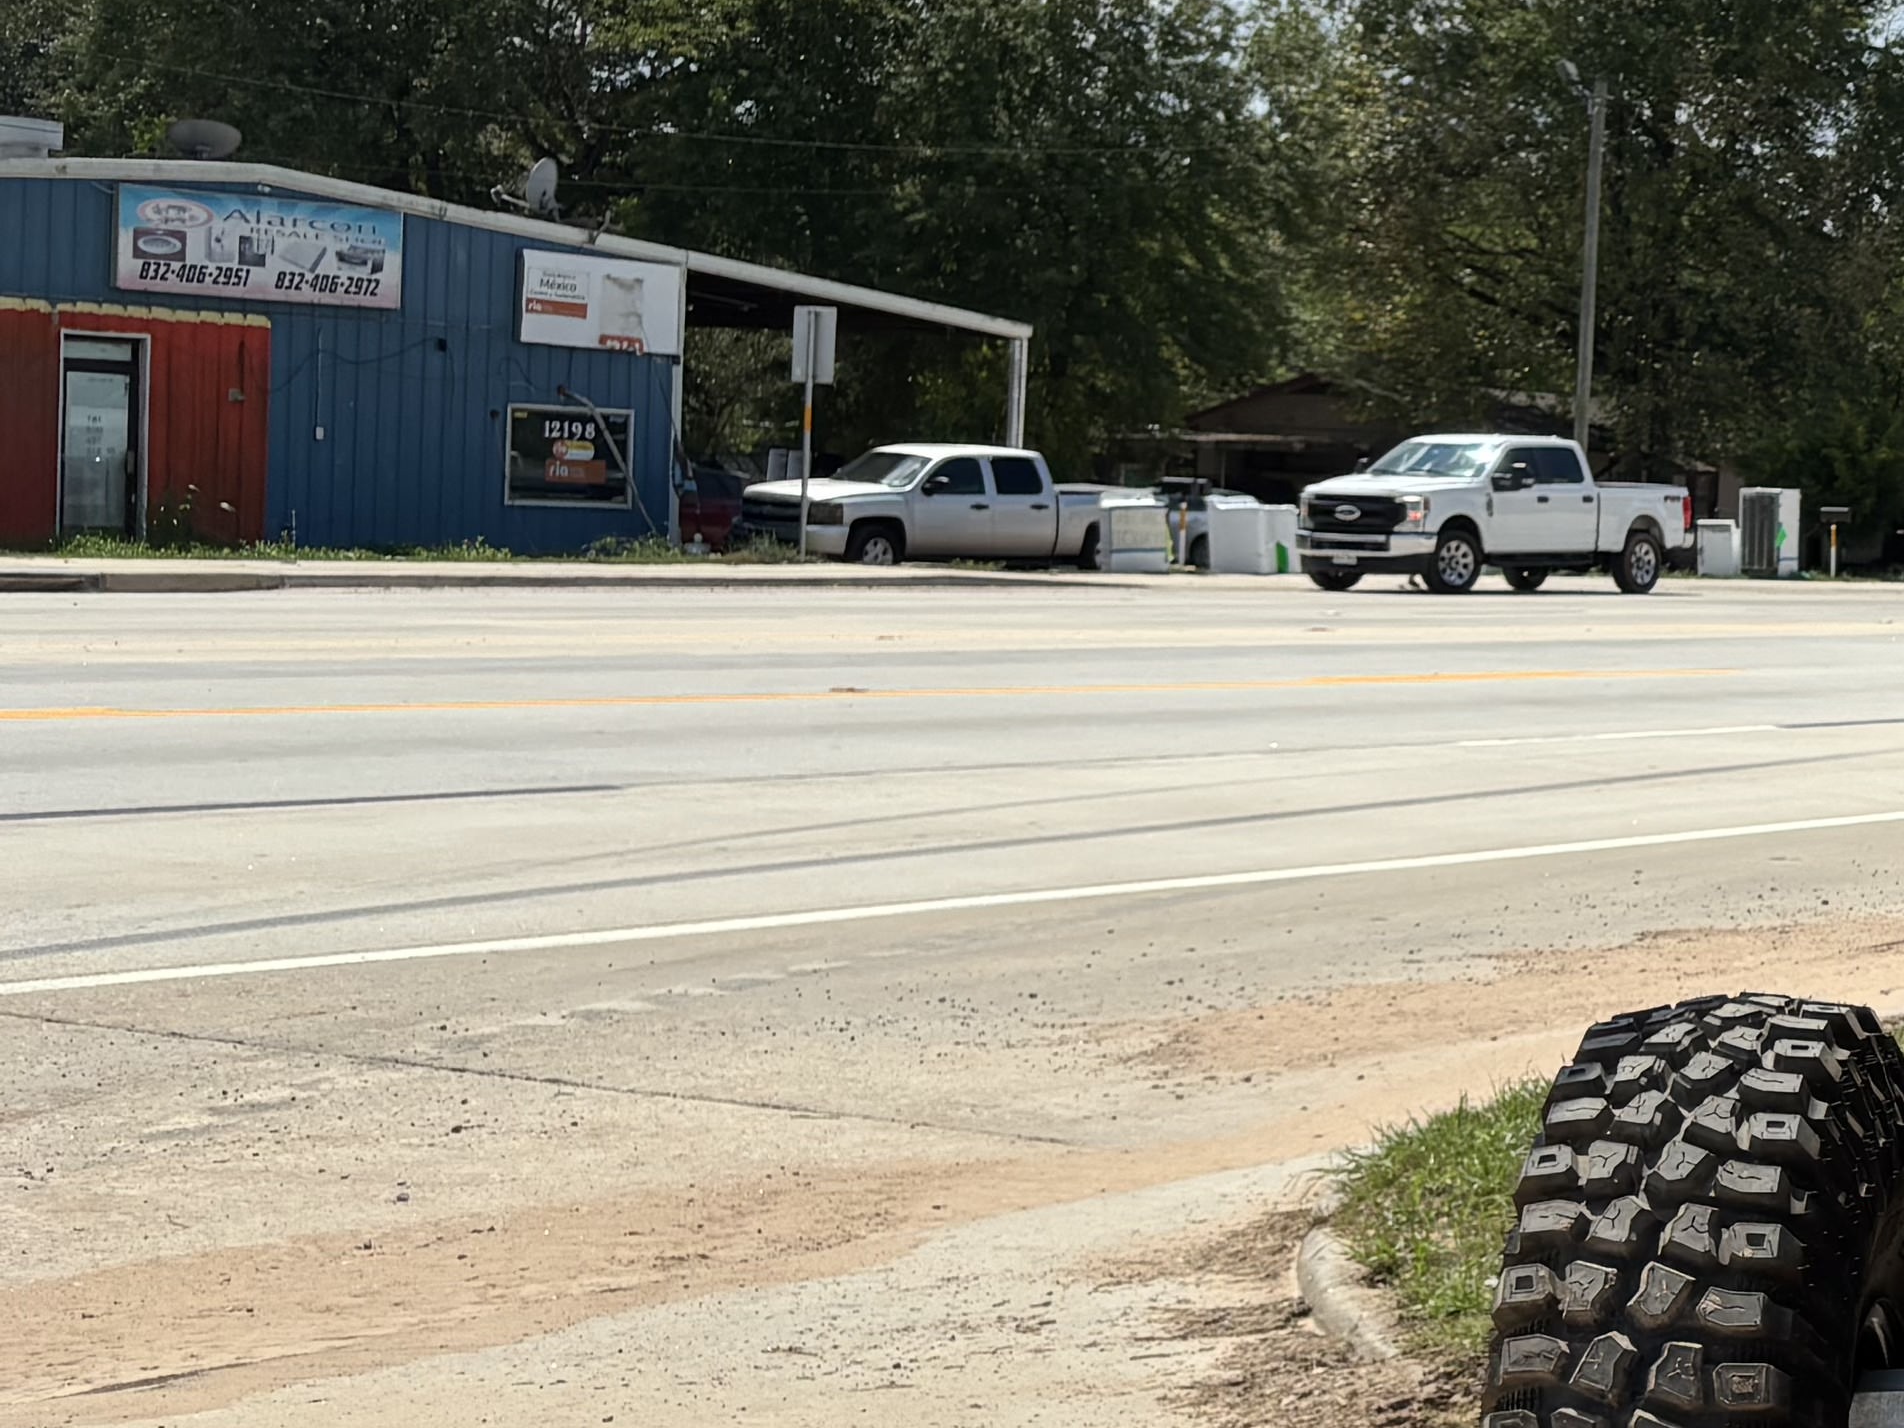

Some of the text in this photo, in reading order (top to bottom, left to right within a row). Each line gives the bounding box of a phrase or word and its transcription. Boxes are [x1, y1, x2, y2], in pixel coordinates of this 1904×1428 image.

[223, 209, 377, 235] Alarcon
[539, 277, 577, 293] México
[544, 420, 596, 440] 12198
